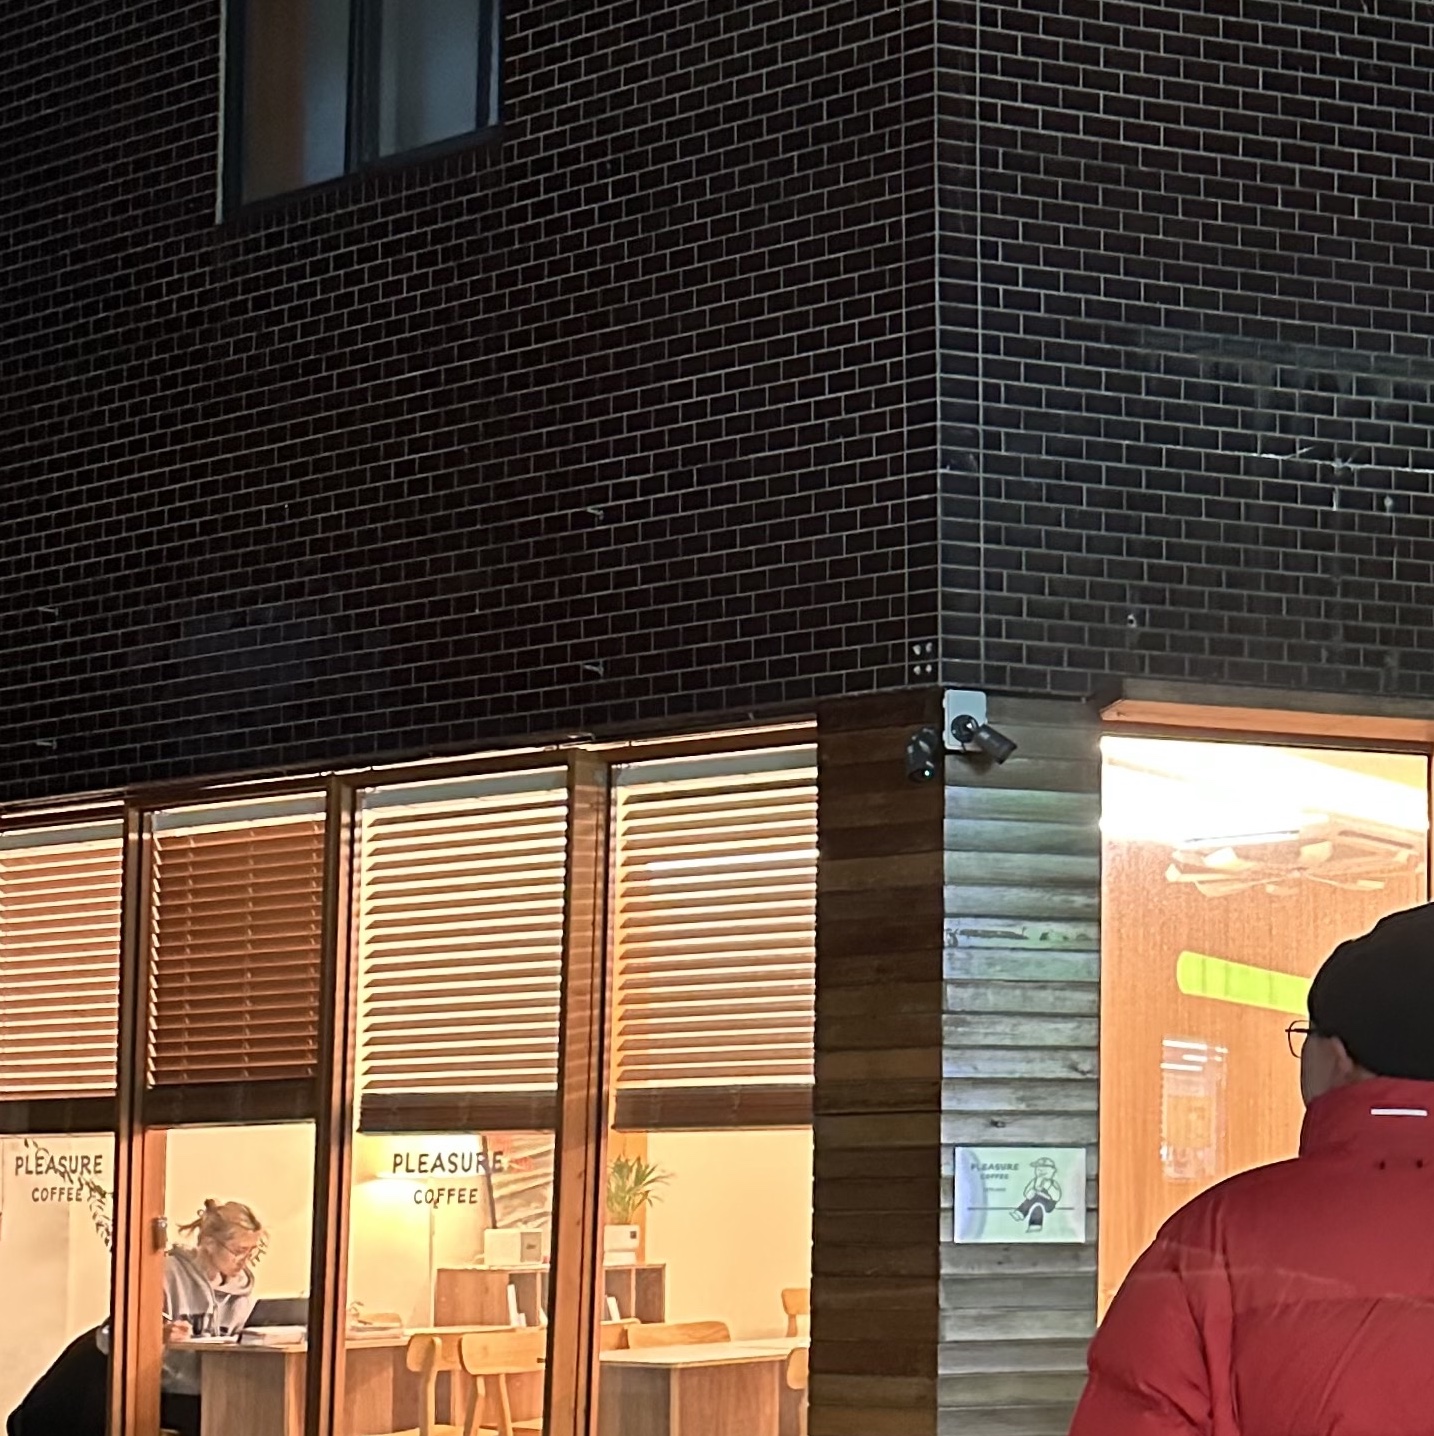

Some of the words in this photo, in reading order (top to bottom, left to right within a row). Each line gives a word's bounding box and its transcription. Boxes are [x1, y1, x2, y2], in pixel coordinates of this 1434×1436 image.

[14, 1154, 104, 1176] PLEASURE
[393, 1150, 504, 1174] PLEASURE
[970, 1162, 1020, 1171] PLEASURE
[31, 1186, 83, 1203] COFFEE
[413, 1187, 479, 1205] COFFEE
